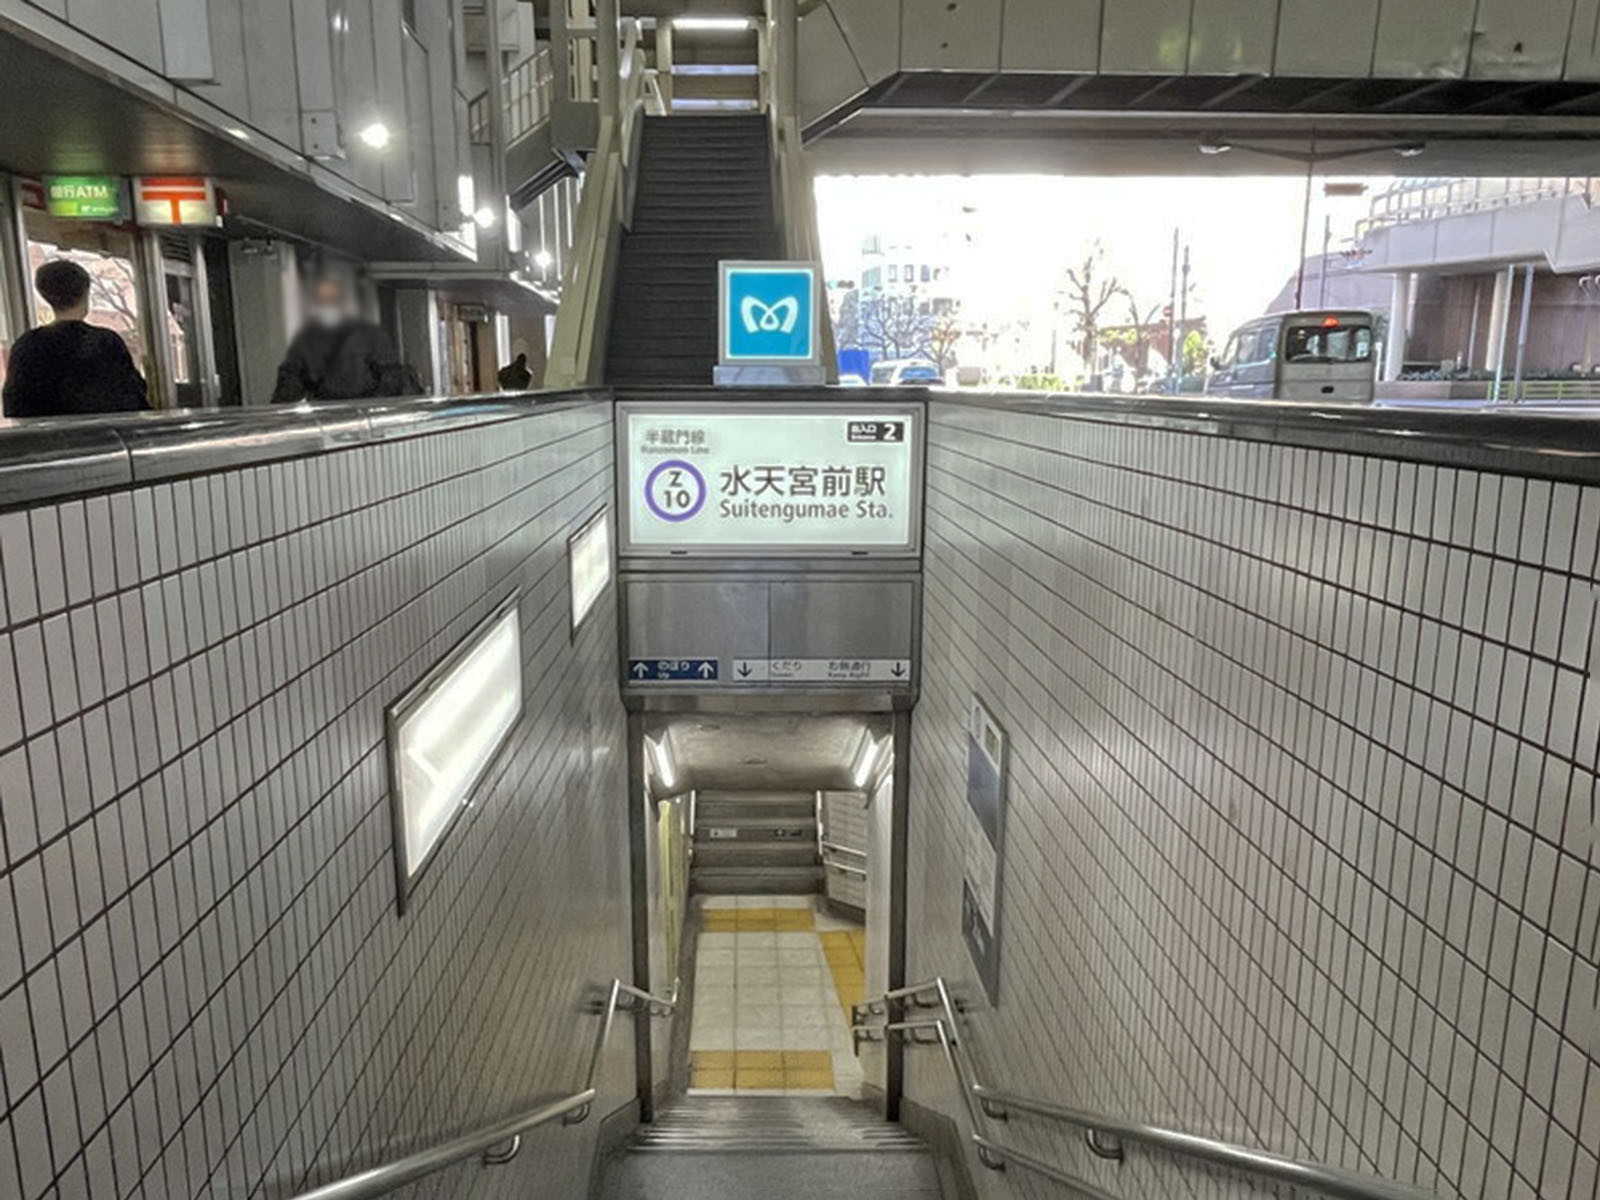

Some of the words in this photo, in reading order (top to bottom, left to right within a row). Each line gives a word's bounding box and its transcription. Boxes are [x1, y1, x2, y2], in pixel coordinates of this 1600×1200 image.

[883, 423, 897, 441] 2
[669, 470, 683, 488] Z
[719, 465, 886, 497] 水天宮前駅
[664, 489, 691, 509] 10
[719, 498, 850, 523] Suitengumae
[856, 500, 894, 519] Sta.
